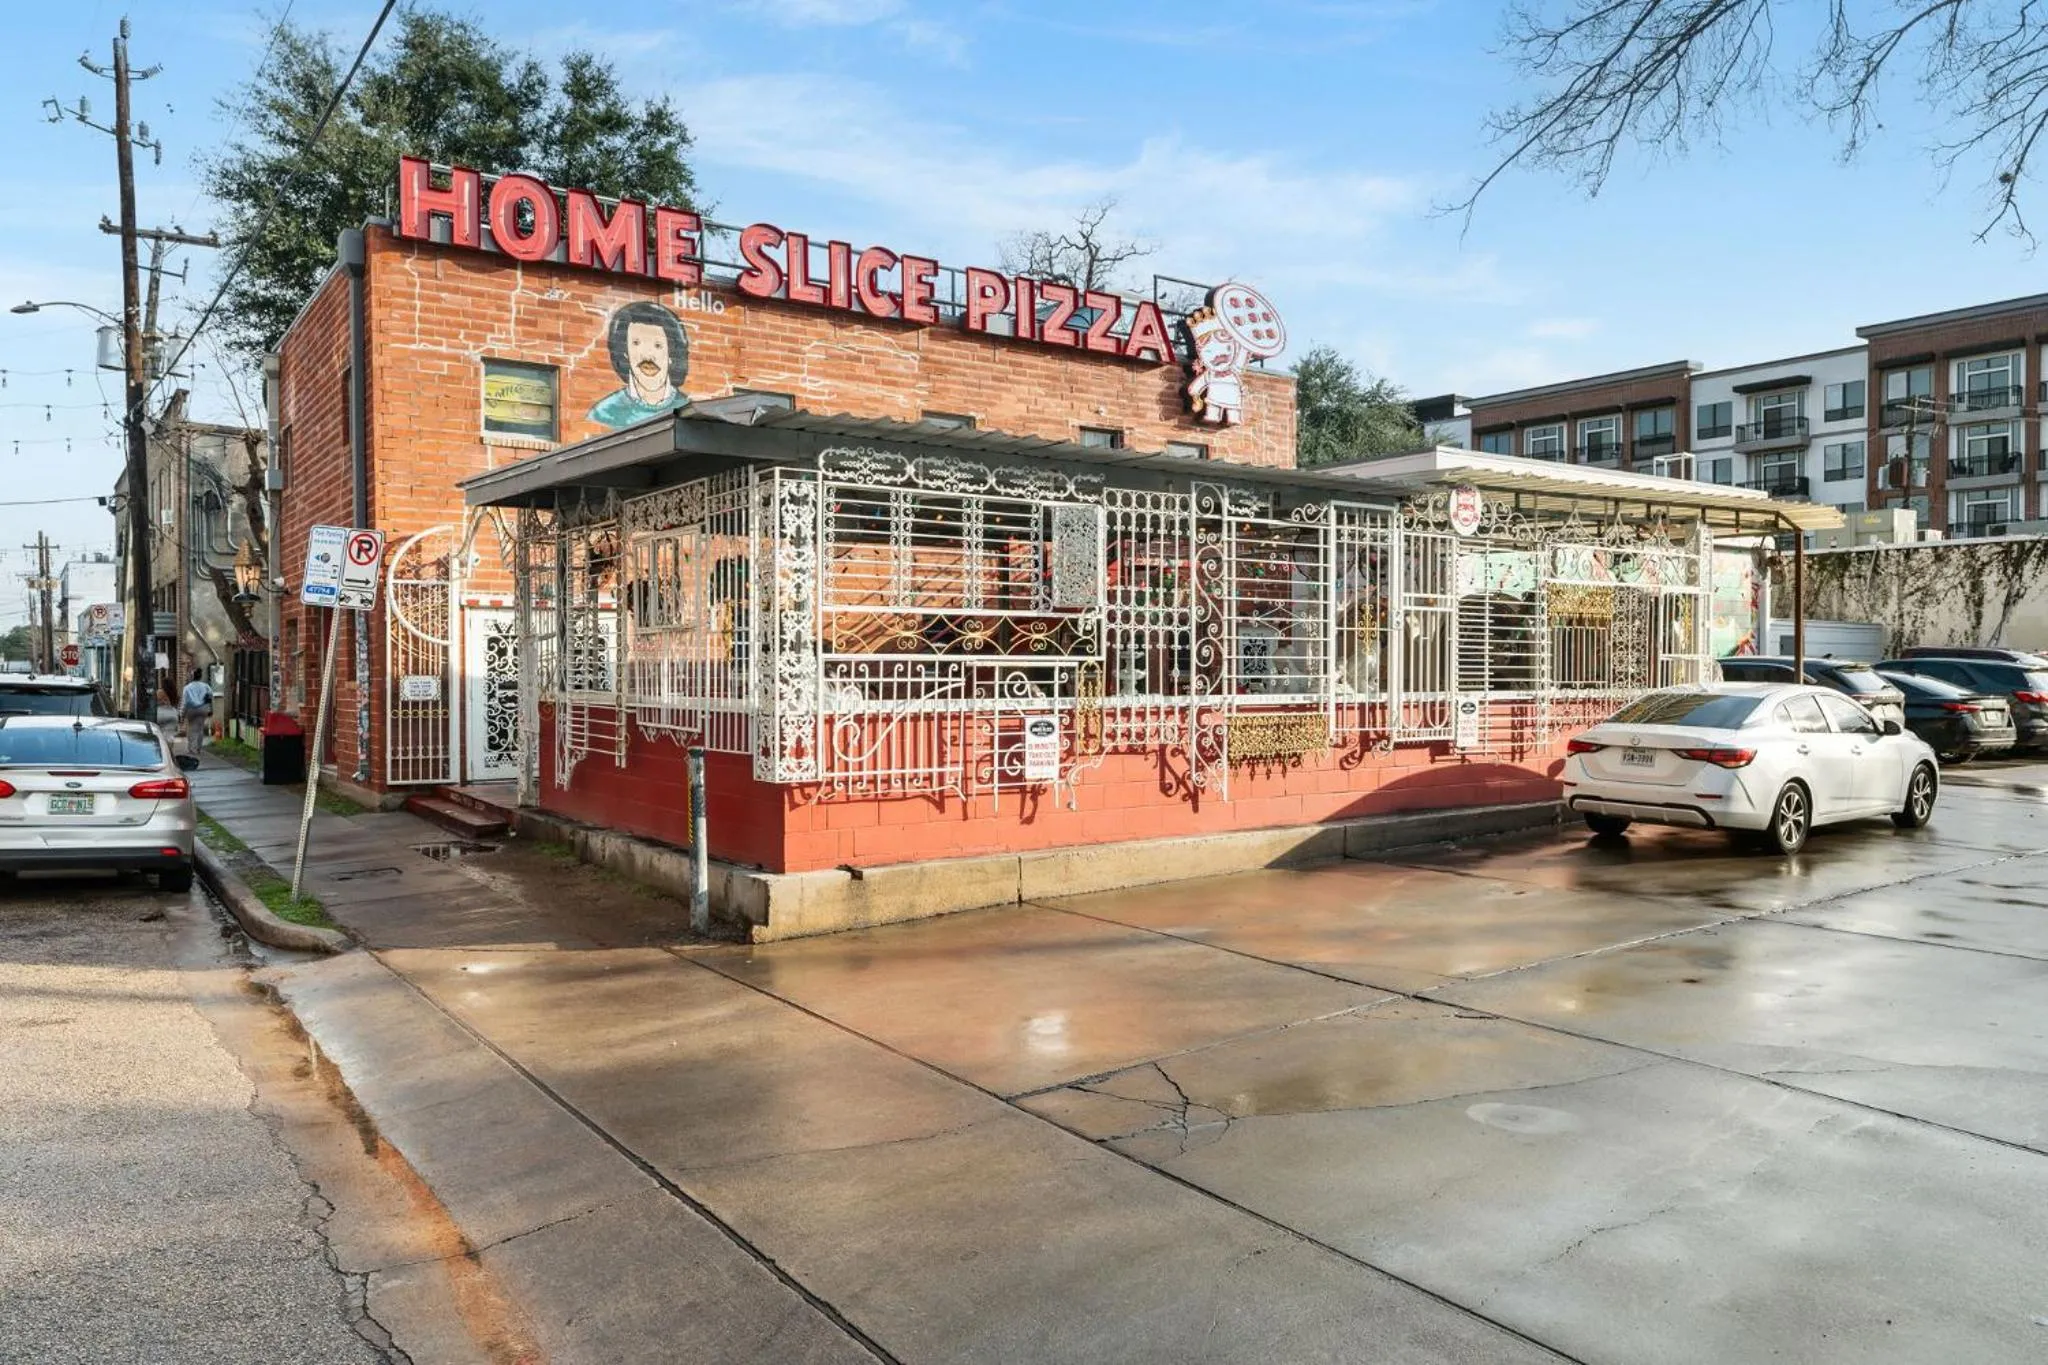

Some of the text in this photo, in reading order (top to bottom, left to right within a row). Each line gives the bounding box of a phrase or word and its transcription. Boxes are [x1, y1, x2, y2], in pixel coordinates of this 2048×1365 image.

[400, 155, 1177, 364] HOME SLICE PIZZA
[673, 285, 725, 315] Hello
[62, 650, 79, 660] STO
